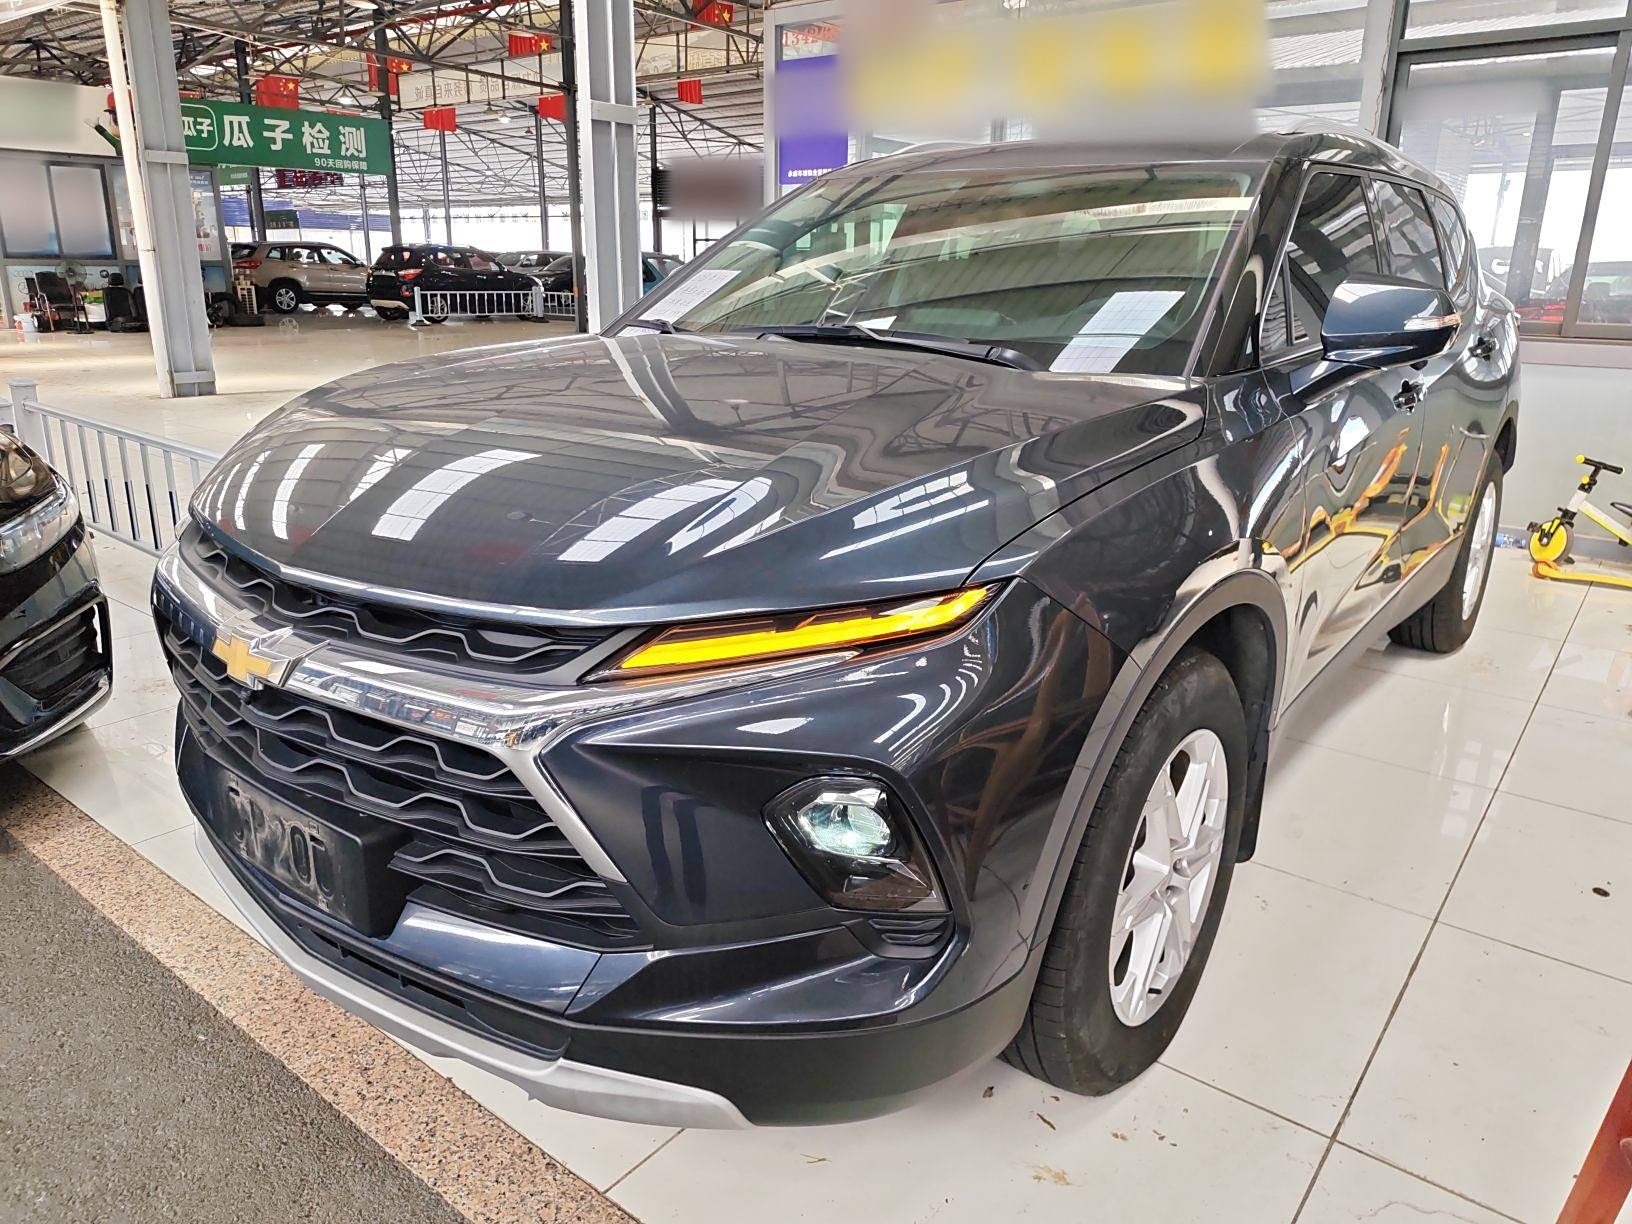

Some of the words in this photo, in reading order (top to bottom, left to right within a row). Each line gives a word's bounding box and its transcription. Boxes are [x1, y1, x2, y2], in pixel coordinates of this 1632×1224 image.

[182, 116, 213, 138] 瓜子
[223, 114, 367, 158] 瓜子检测
[314, 157, 368, 171] 90天回购保障
